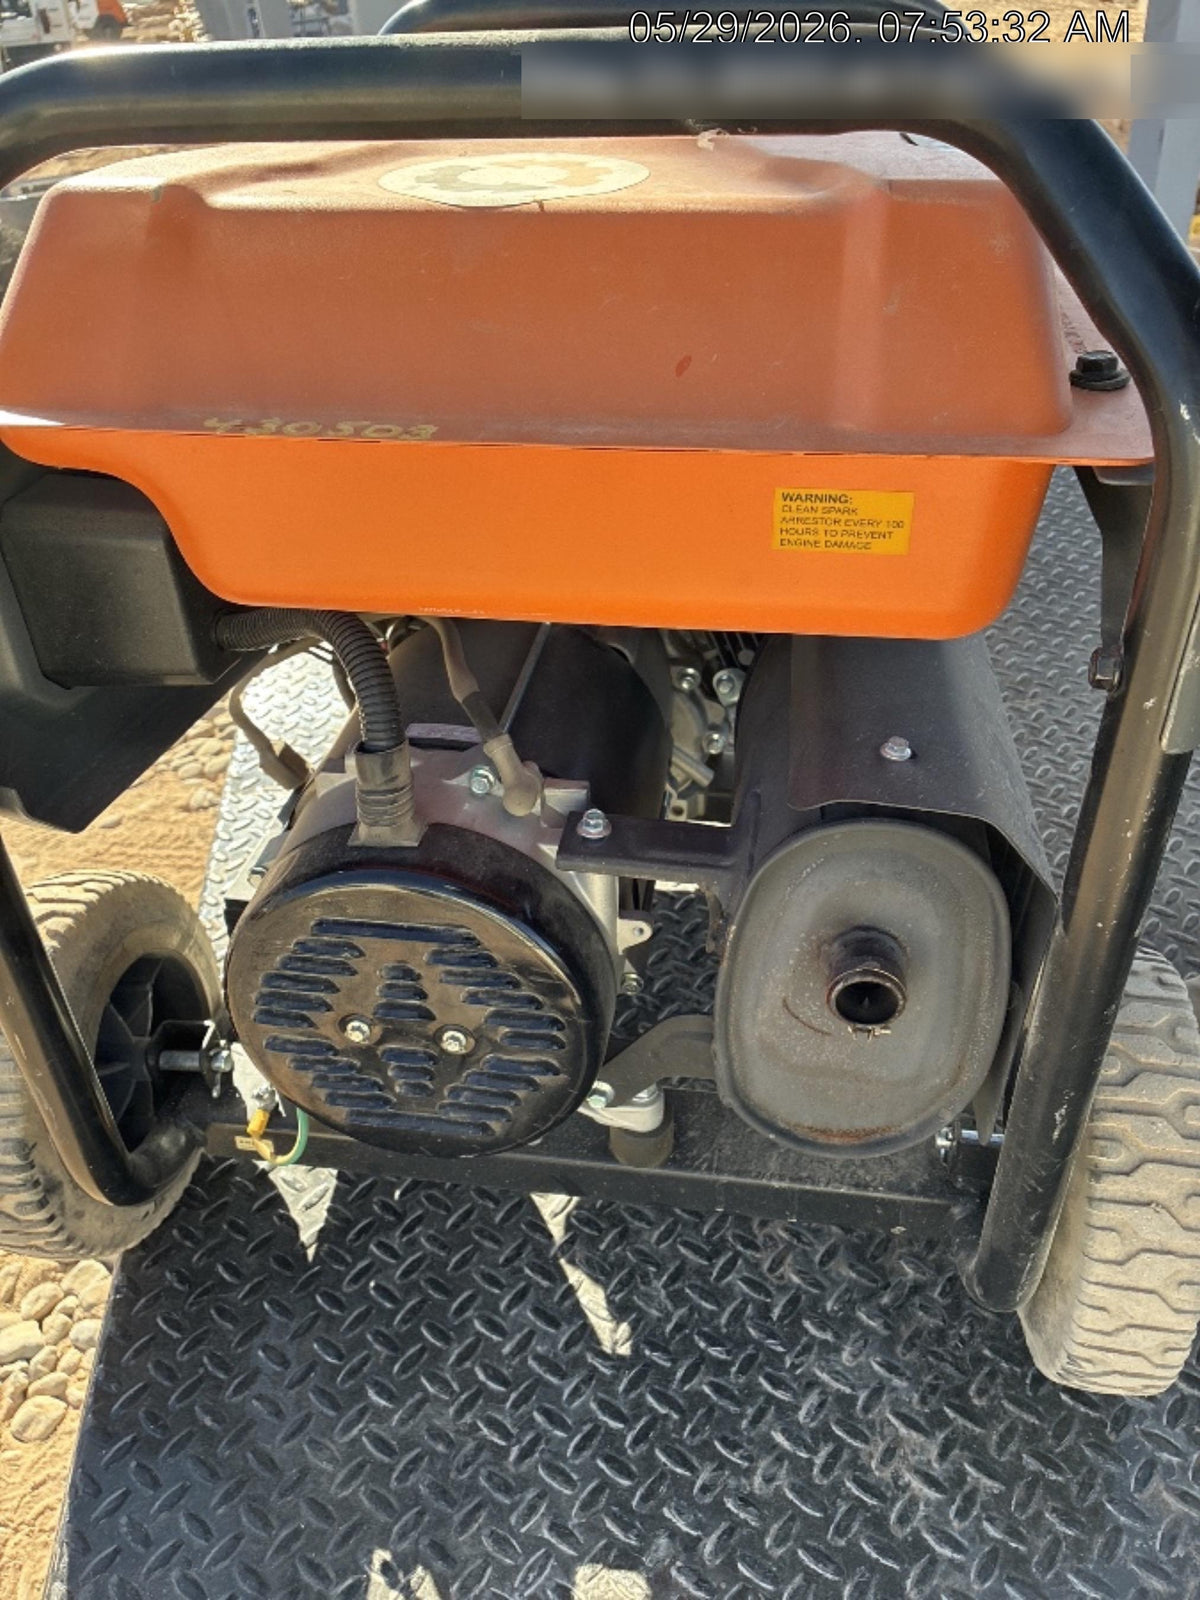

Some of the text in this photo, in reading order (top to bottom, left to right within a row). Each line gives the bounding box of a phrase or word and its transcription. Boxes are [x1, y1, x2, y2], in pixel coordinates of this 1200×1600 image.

[781, 492, 853, 505] WARNING:
[781, 504, 858, 516] CLEAN SPARK
[779, 516, 904, 529] ARRESTOR EVERY 100
[779, 527, 894, 540] HOURS TO PREVENT
[779, 538, 872, 550] ENGINE DAMAGE
